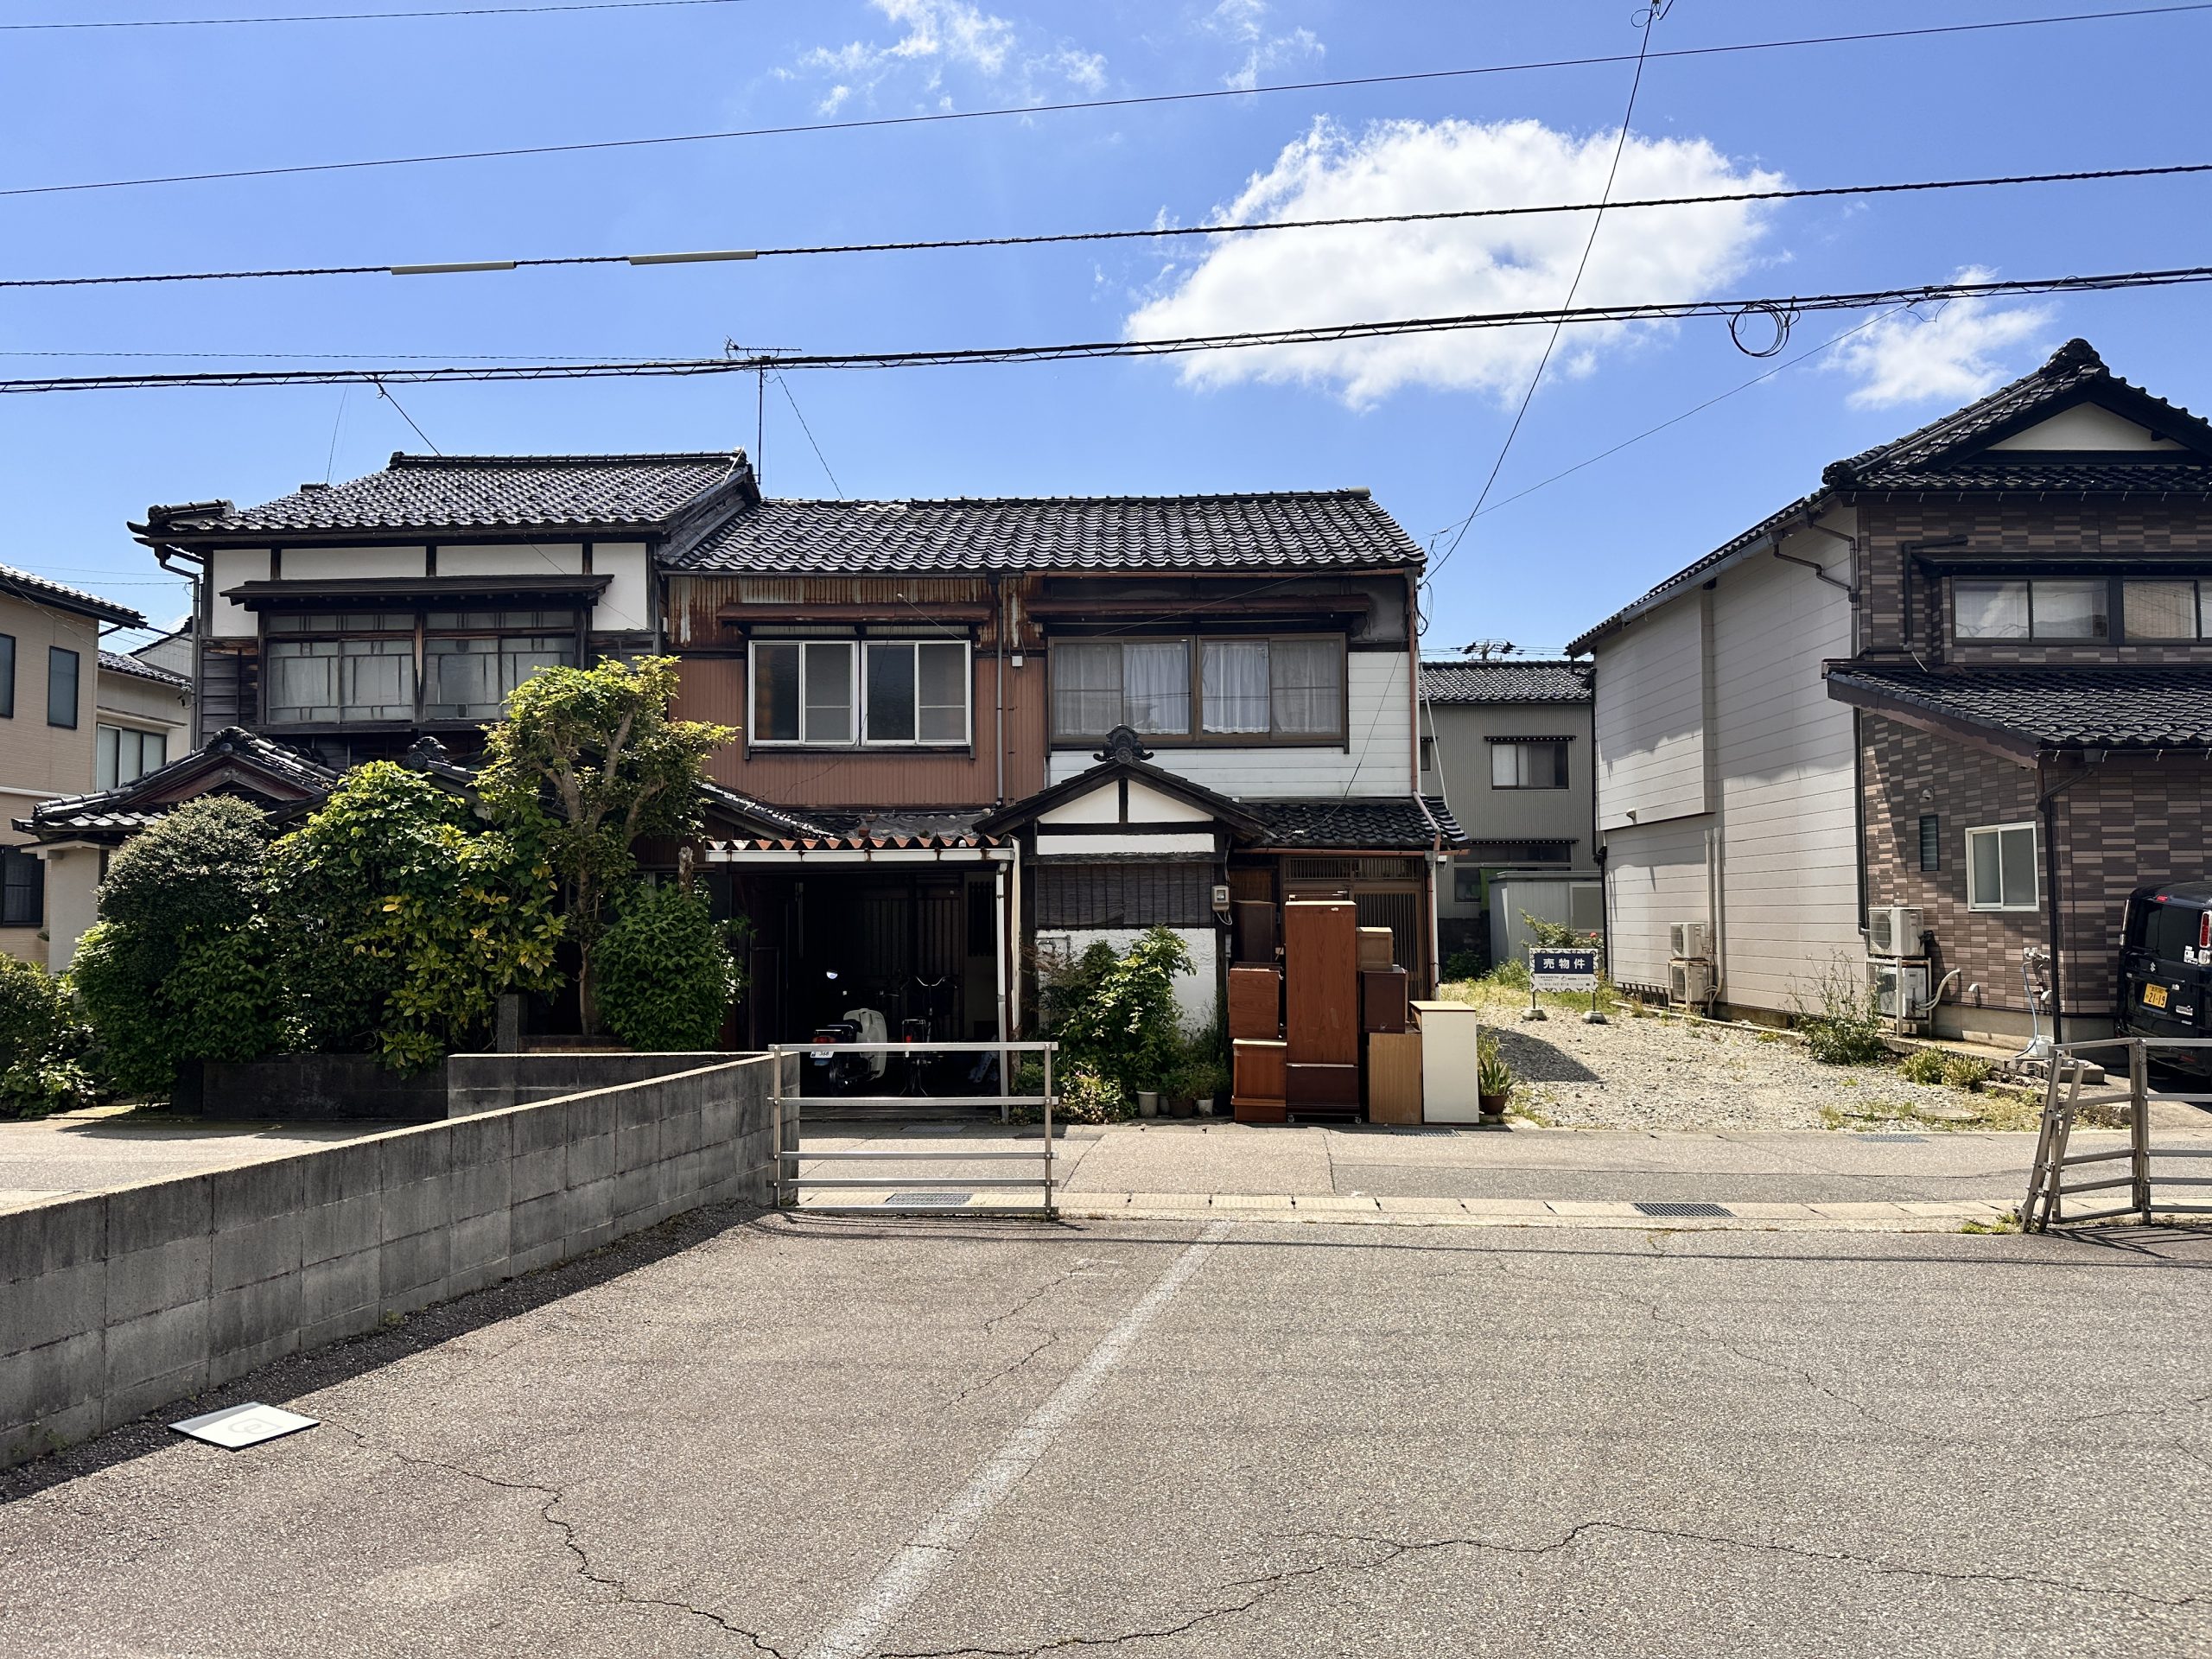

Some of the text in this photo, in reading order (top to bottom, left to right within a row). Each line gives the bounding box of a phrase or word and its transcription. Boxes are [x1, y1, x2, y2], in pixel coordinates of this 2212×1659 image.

[1543, 958, 1586, 969] 売物件
[2148, 992, 2165, 1006] 21-19
